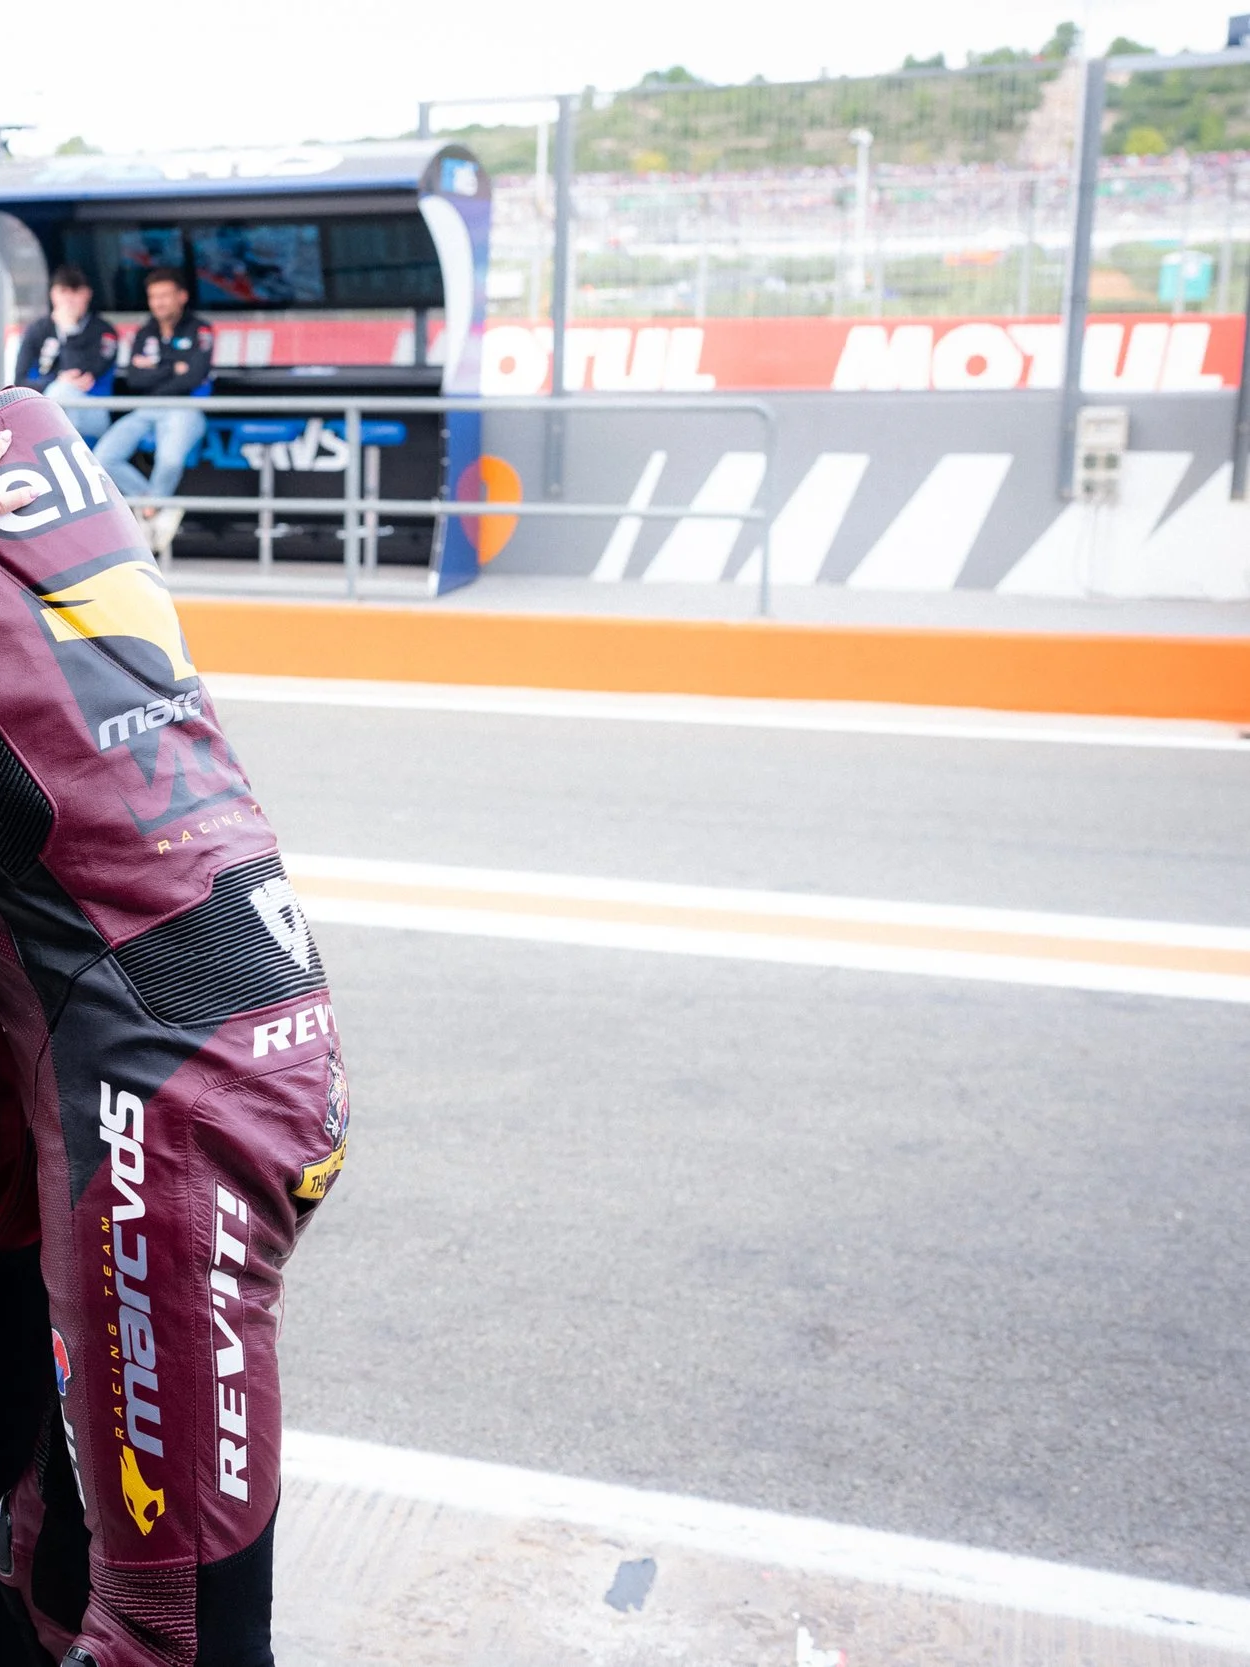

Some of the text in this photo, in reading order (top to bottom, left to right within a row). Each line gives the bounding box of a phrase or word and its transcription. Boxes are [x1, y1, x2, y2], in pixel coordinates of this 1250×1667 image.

[831, 323, 1223, 392] MOTUL
[157, 811, 243, 855] RACING
[101, 1216, 125, 1440] RACING TEAM
[211, 1184, 248, 1502] REV'IT!
